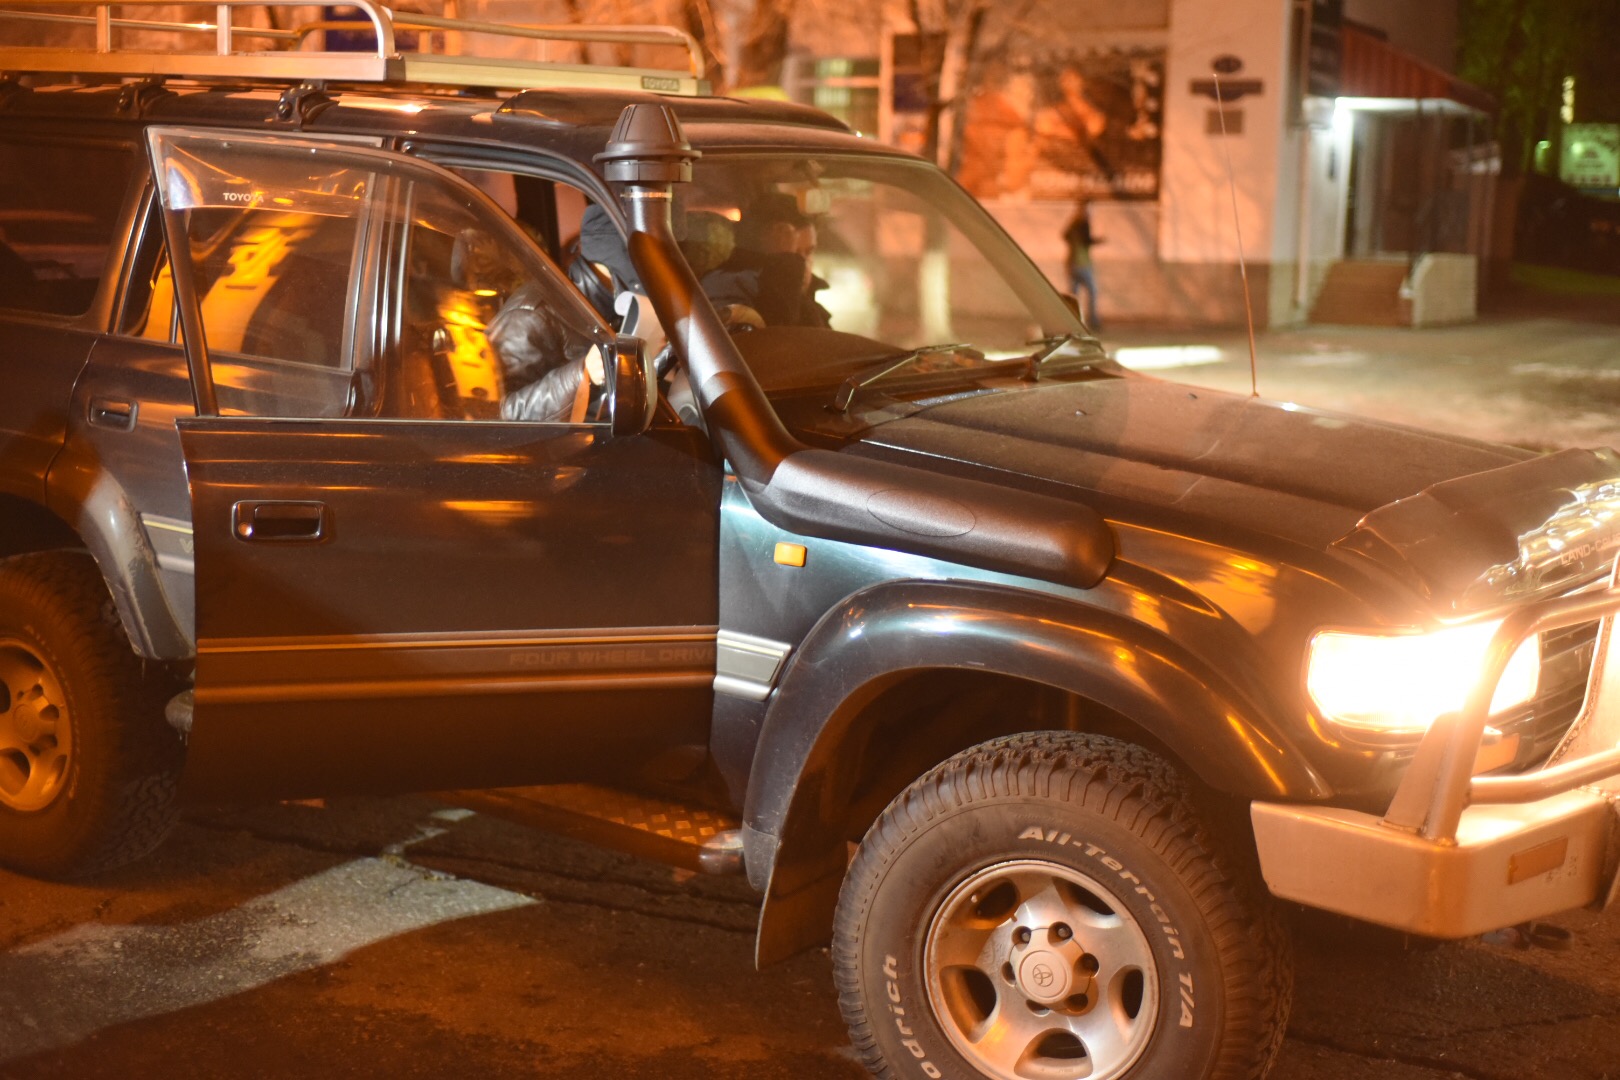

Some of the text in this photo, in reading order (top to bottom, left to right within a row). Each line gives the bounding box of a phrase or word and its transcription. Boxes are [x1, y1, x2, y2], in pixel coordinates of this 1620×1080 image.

[643, 77, 678, 90] TOYOTA
[509, 651, 570, 665] FOUR
[577, 649, 651, 664] WHEEL
[1178, 972, 1195, 1028] T/A
